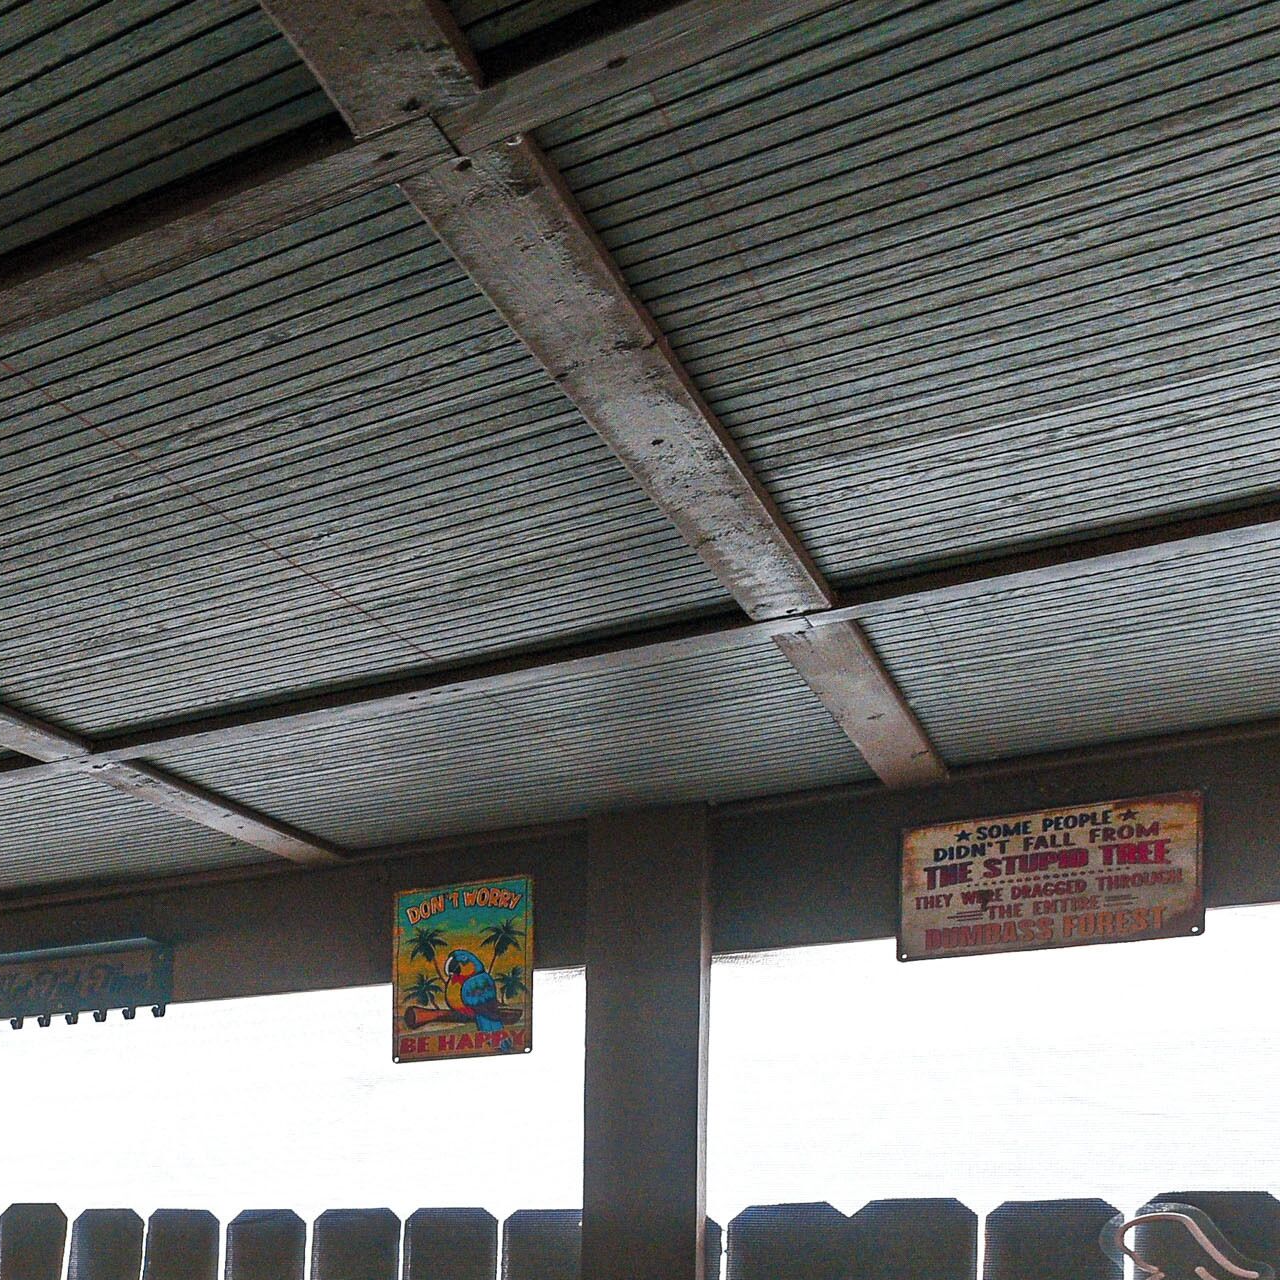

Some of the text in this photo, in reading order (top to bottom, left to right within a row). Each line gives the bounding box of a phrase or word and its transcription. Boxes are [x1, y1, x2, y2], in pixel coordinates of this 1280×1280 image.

[934, 821, 1159, 862] DIDN'T FALL FROM
[976, 810, 1112, 840] SOME PEOPLE
[924, 838, 1171, 890] THE STUPID TREE
[405, 887, 522, 925] DON'T WORRY
[915, 868, 1182, 910] THEY WERE DRAGGED THROUGH
[988, 895, 1100, 920] THE ENTIRE
[925, 906, 1168, 950] DUMBASS FOREST
[400, 1030, 527, 1055] BE HAPPY
